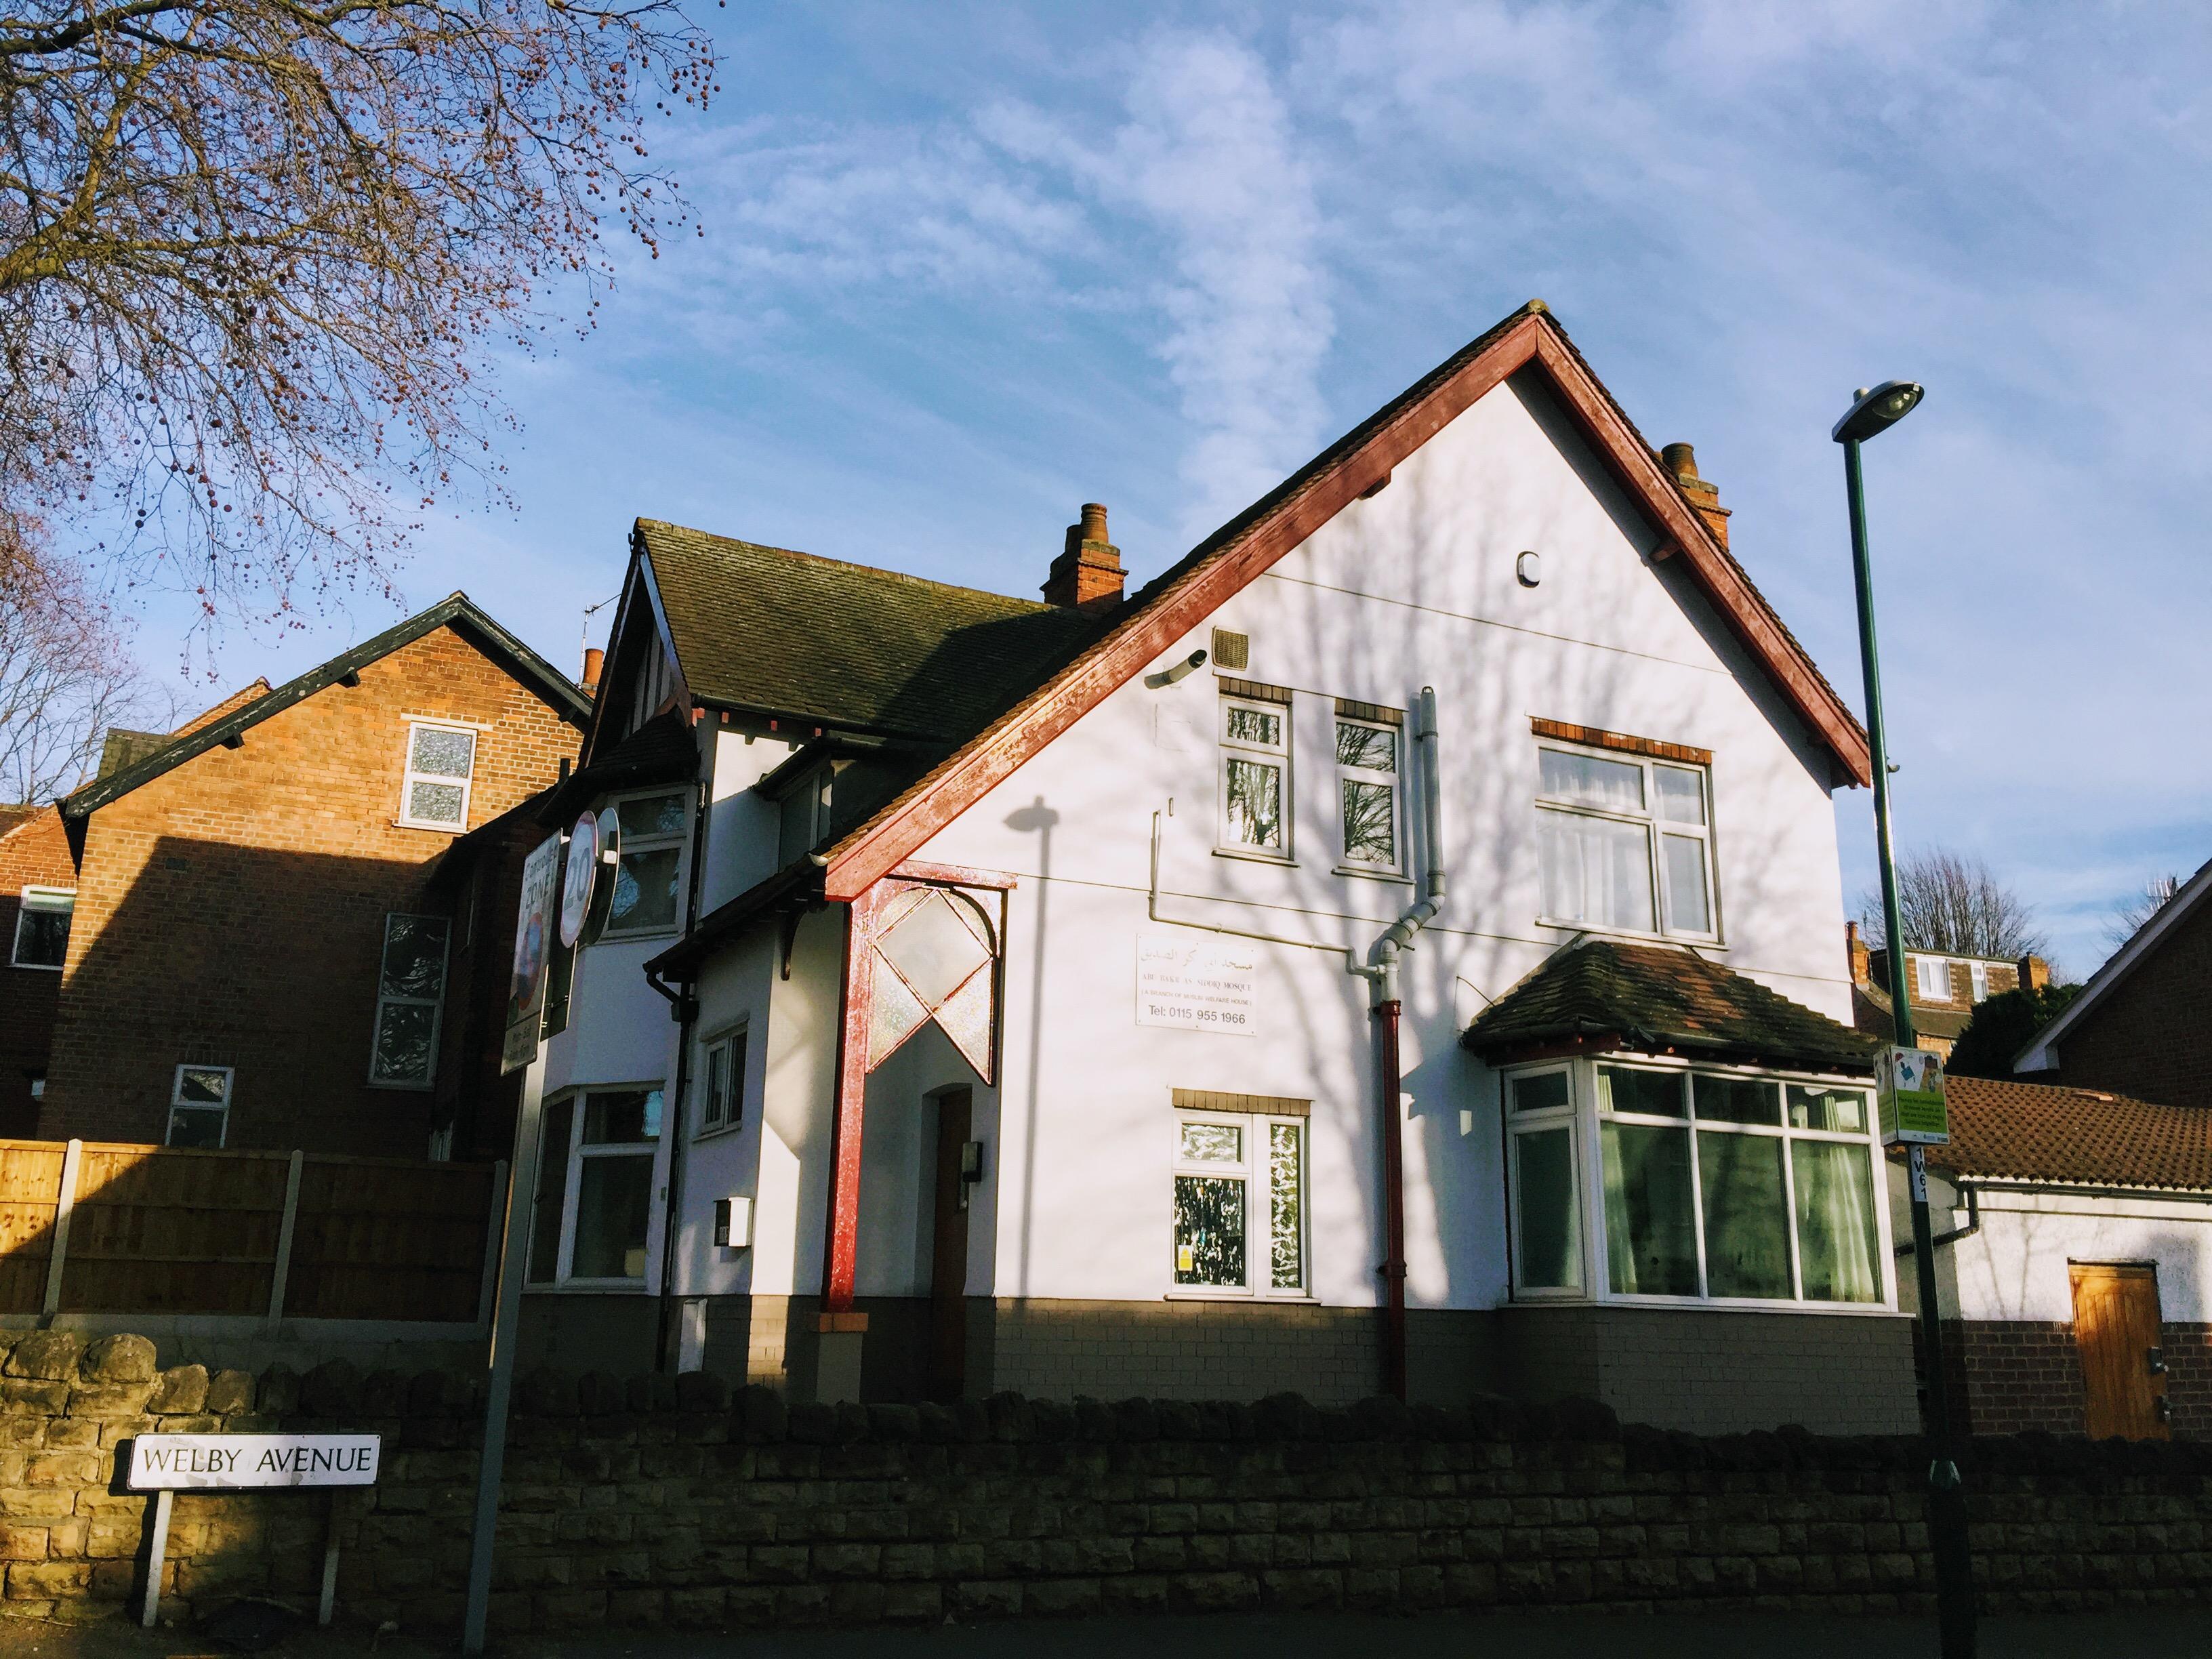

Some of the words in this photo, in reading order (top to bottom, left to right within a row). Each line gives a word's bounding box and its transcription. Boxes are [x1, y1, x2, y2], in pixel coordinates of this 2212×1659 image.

[564, 847, 590, 912] 20
[525, 878, 549, 909] ZONE
[1224, 982, 1252, 992] MOSQUE
[1149, 1004, 1166, 1017] Tel:
[1169, 1007, 1192, 1019] 0115
[1197, 1010, 1217, 1021] 955
[1221, 1012, 1246, 1024] 1966
[144, 1448, 243, 1473] WELBY
[255, 1447, 372, 1473] AVENUE
